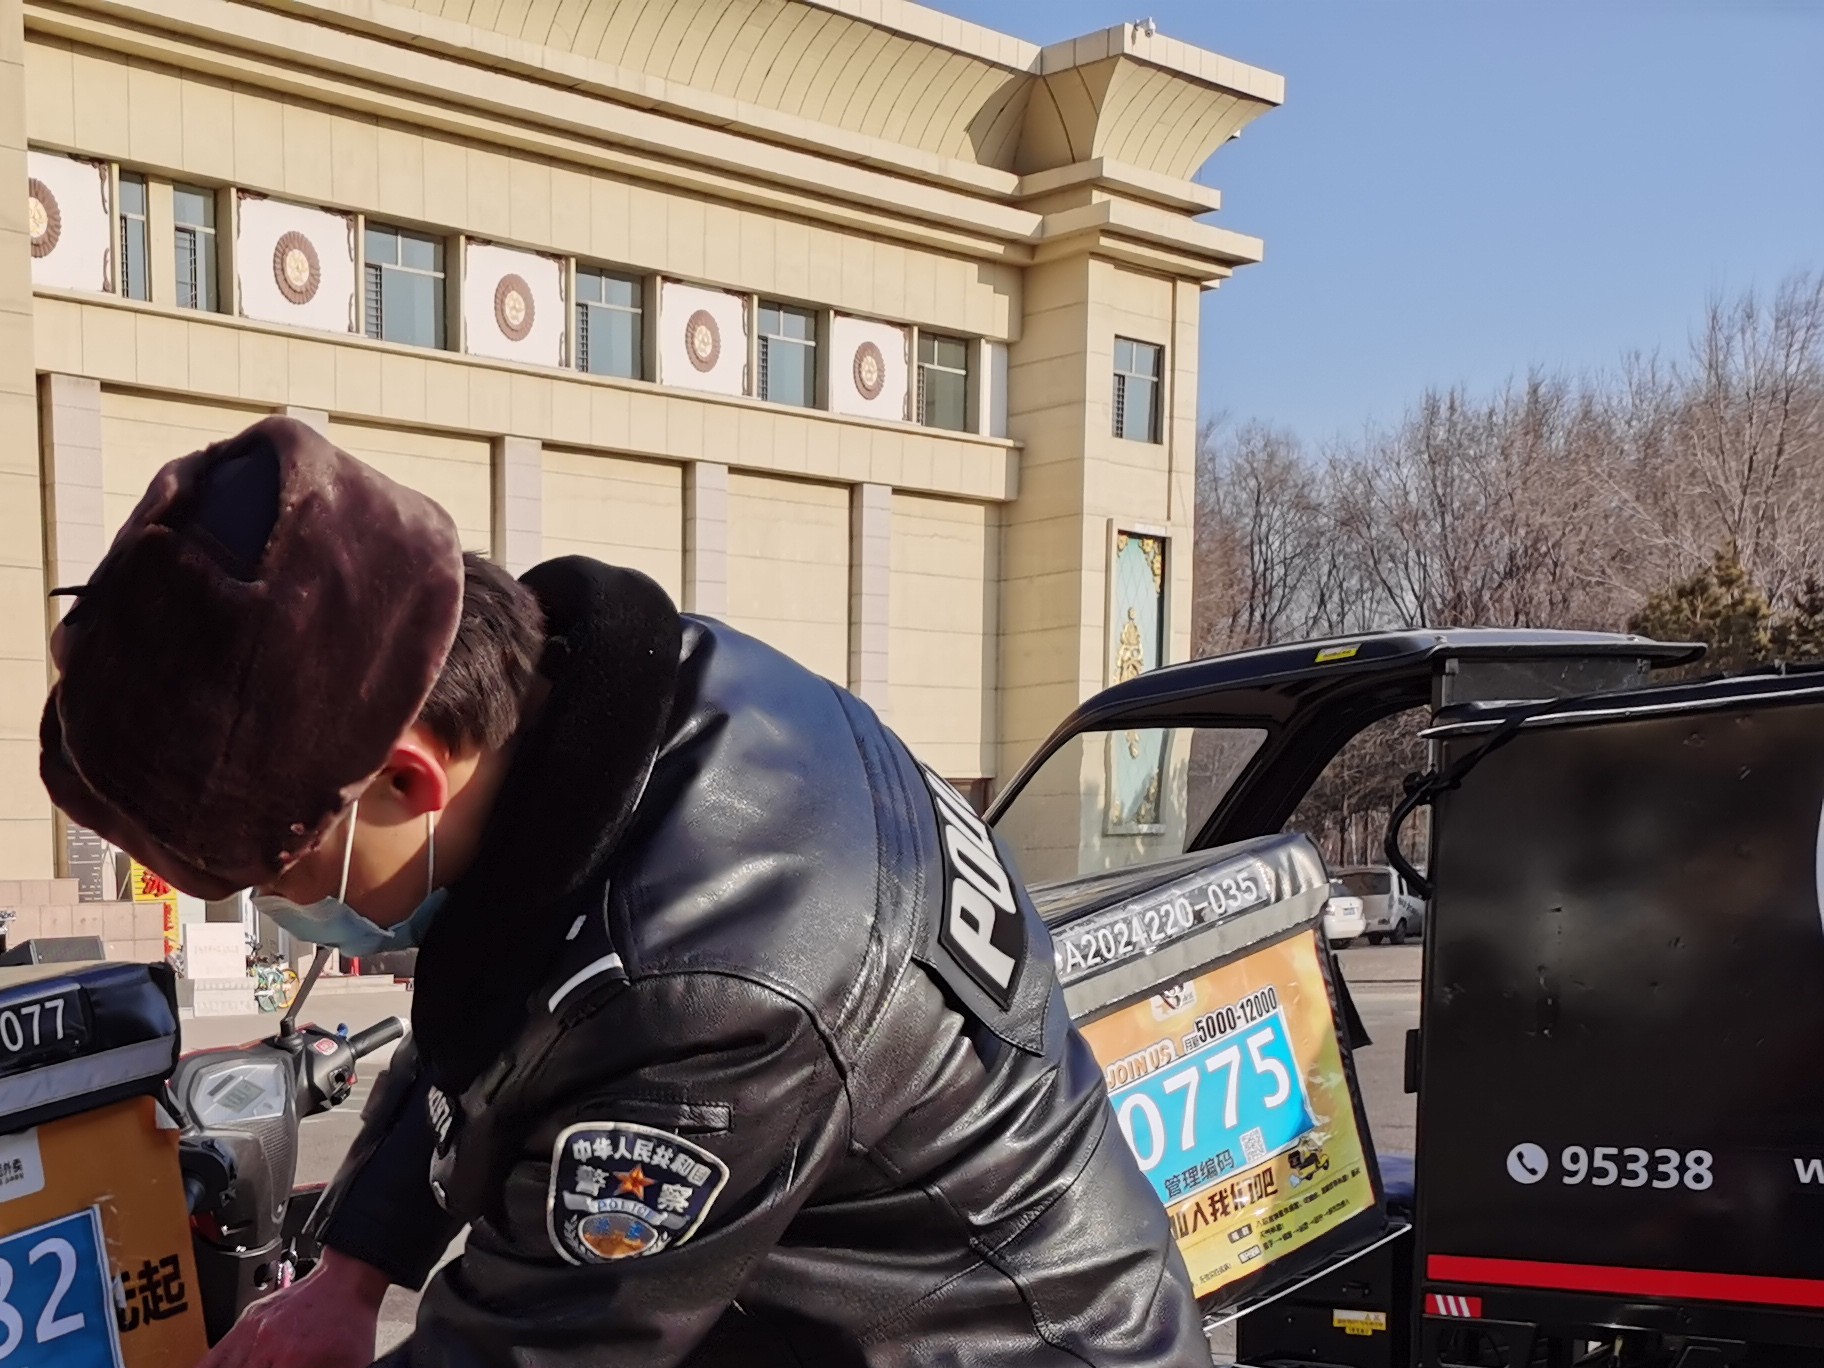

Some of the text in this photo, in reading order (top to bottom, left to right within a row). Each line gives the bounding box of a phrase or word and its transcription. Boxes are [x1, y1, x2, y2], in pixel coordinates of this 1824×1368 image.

[1065, 870, 1258, 974] A2024220-035
[1117, 1027, 1291, 1172] 0775
[572, 1135, 712, 1187] 中华人民共和国
[1164, 1149, 1236, 1198] 管理编码
[1561, 1145, 1714, 1191] 95338
